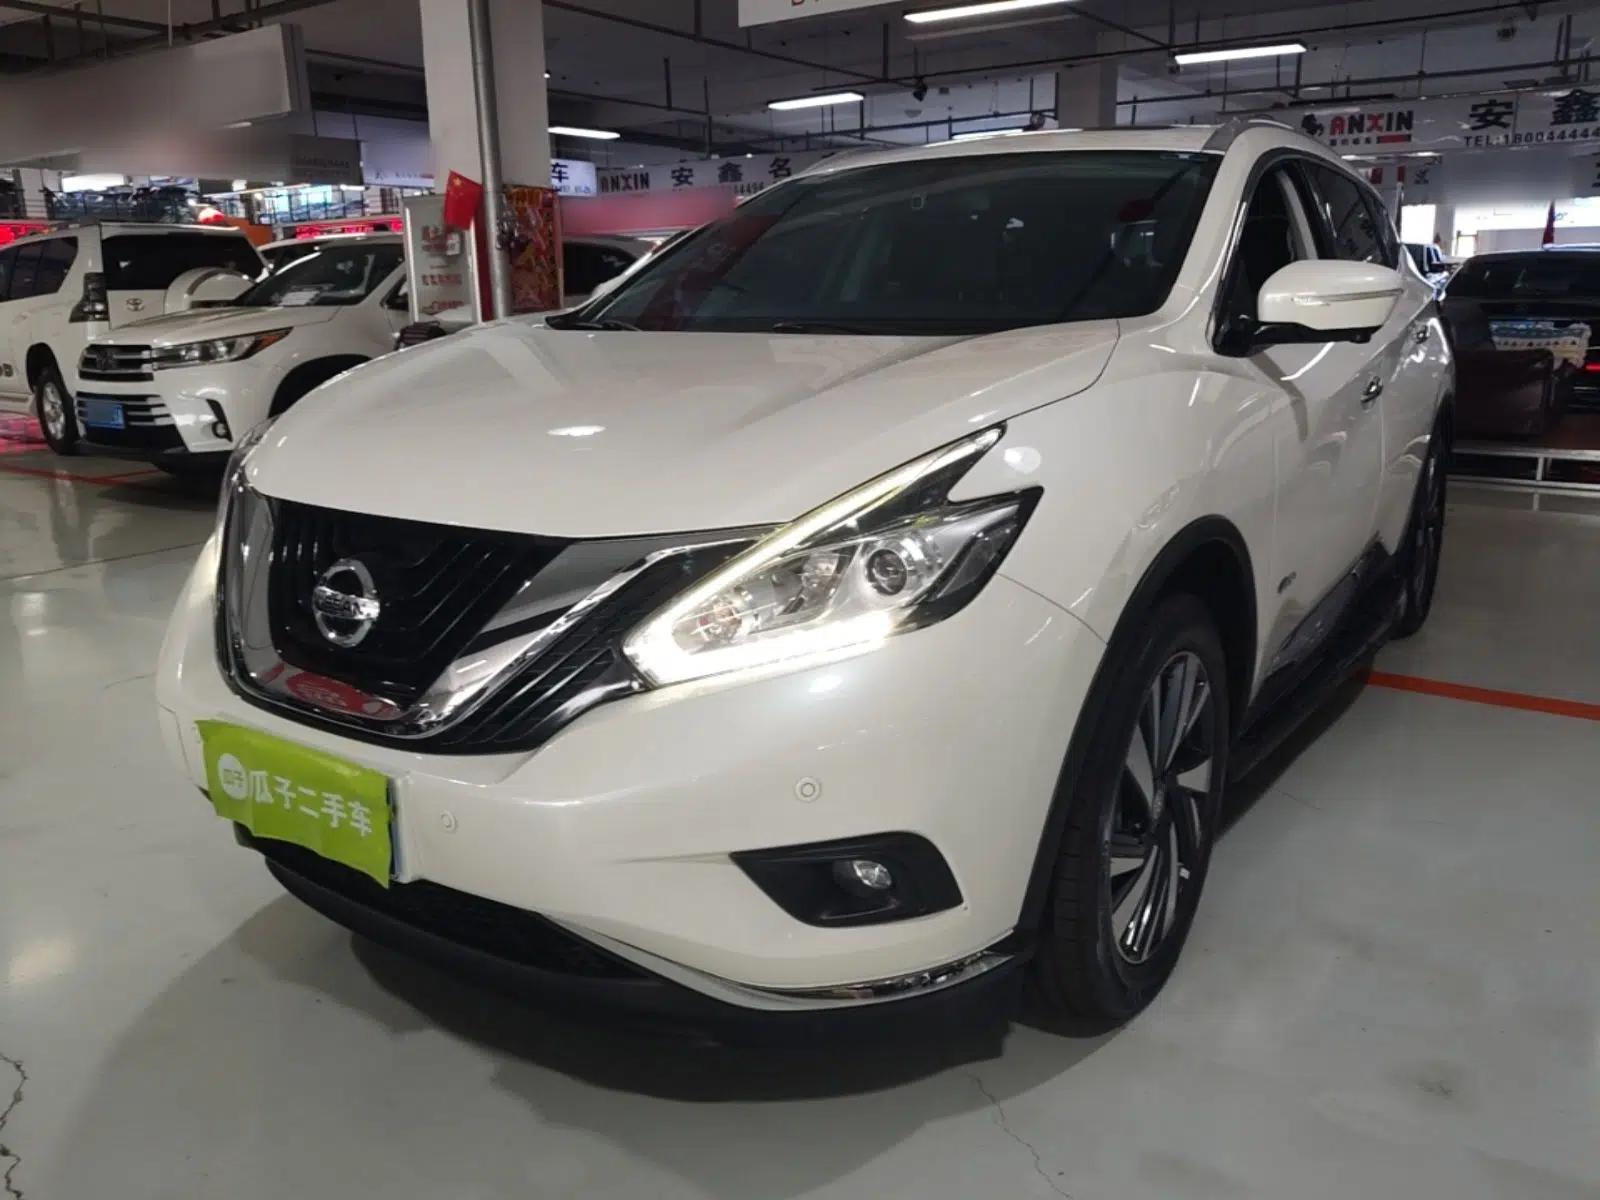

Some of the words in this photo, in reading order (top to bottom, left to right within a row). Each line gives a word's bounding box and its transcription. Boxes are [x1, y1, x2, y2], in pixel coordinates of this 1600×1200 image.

[1329, 110, 1414, 136] ANXIN
[601, 172, 651, 193] ANXIN
[250, 769, 372, 837] 瓜子二手车
